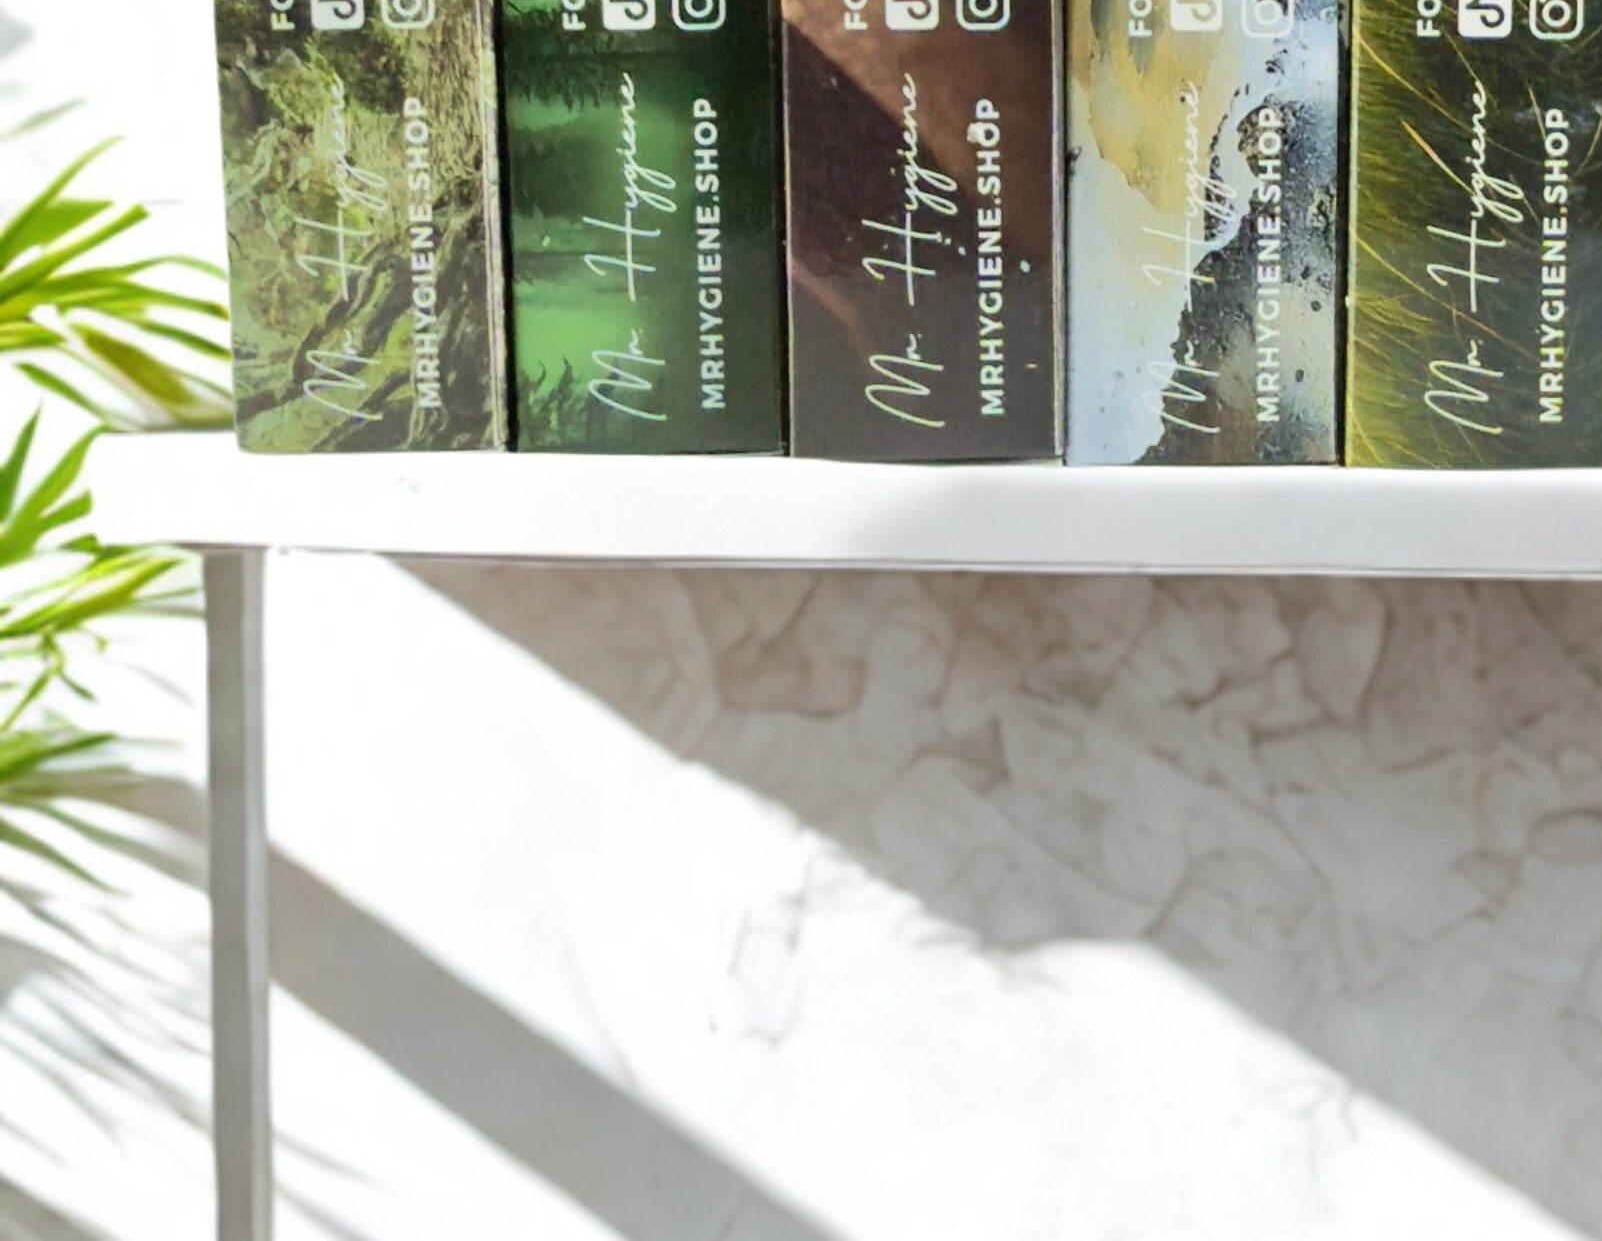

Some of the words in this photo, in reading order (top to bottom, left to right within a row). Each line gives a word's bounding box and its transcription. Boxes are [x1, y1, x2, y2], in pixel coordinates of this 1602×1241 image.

[295, 71, 388, 301] Hygiene
[403, 97, 441, 409] MRHYGIENE.SHOP
[582, 72, 677, 301] Hygiene
[693, 98, 725, 410] MRHYGIENE.SHOP
[861, 73, 958, 306] Hygiene
[971, 99, 1005, 415] MRHYGIENE.SHOP
[1141, 81, 1237, 312] Hygiene
[1256, 107, 1282, 422] MRHYGIENE.SHOP
[1426, 79, 1524, 313] Hygiene
[1538, 108, 1570, 423] MRHYGIENE.SHOP
